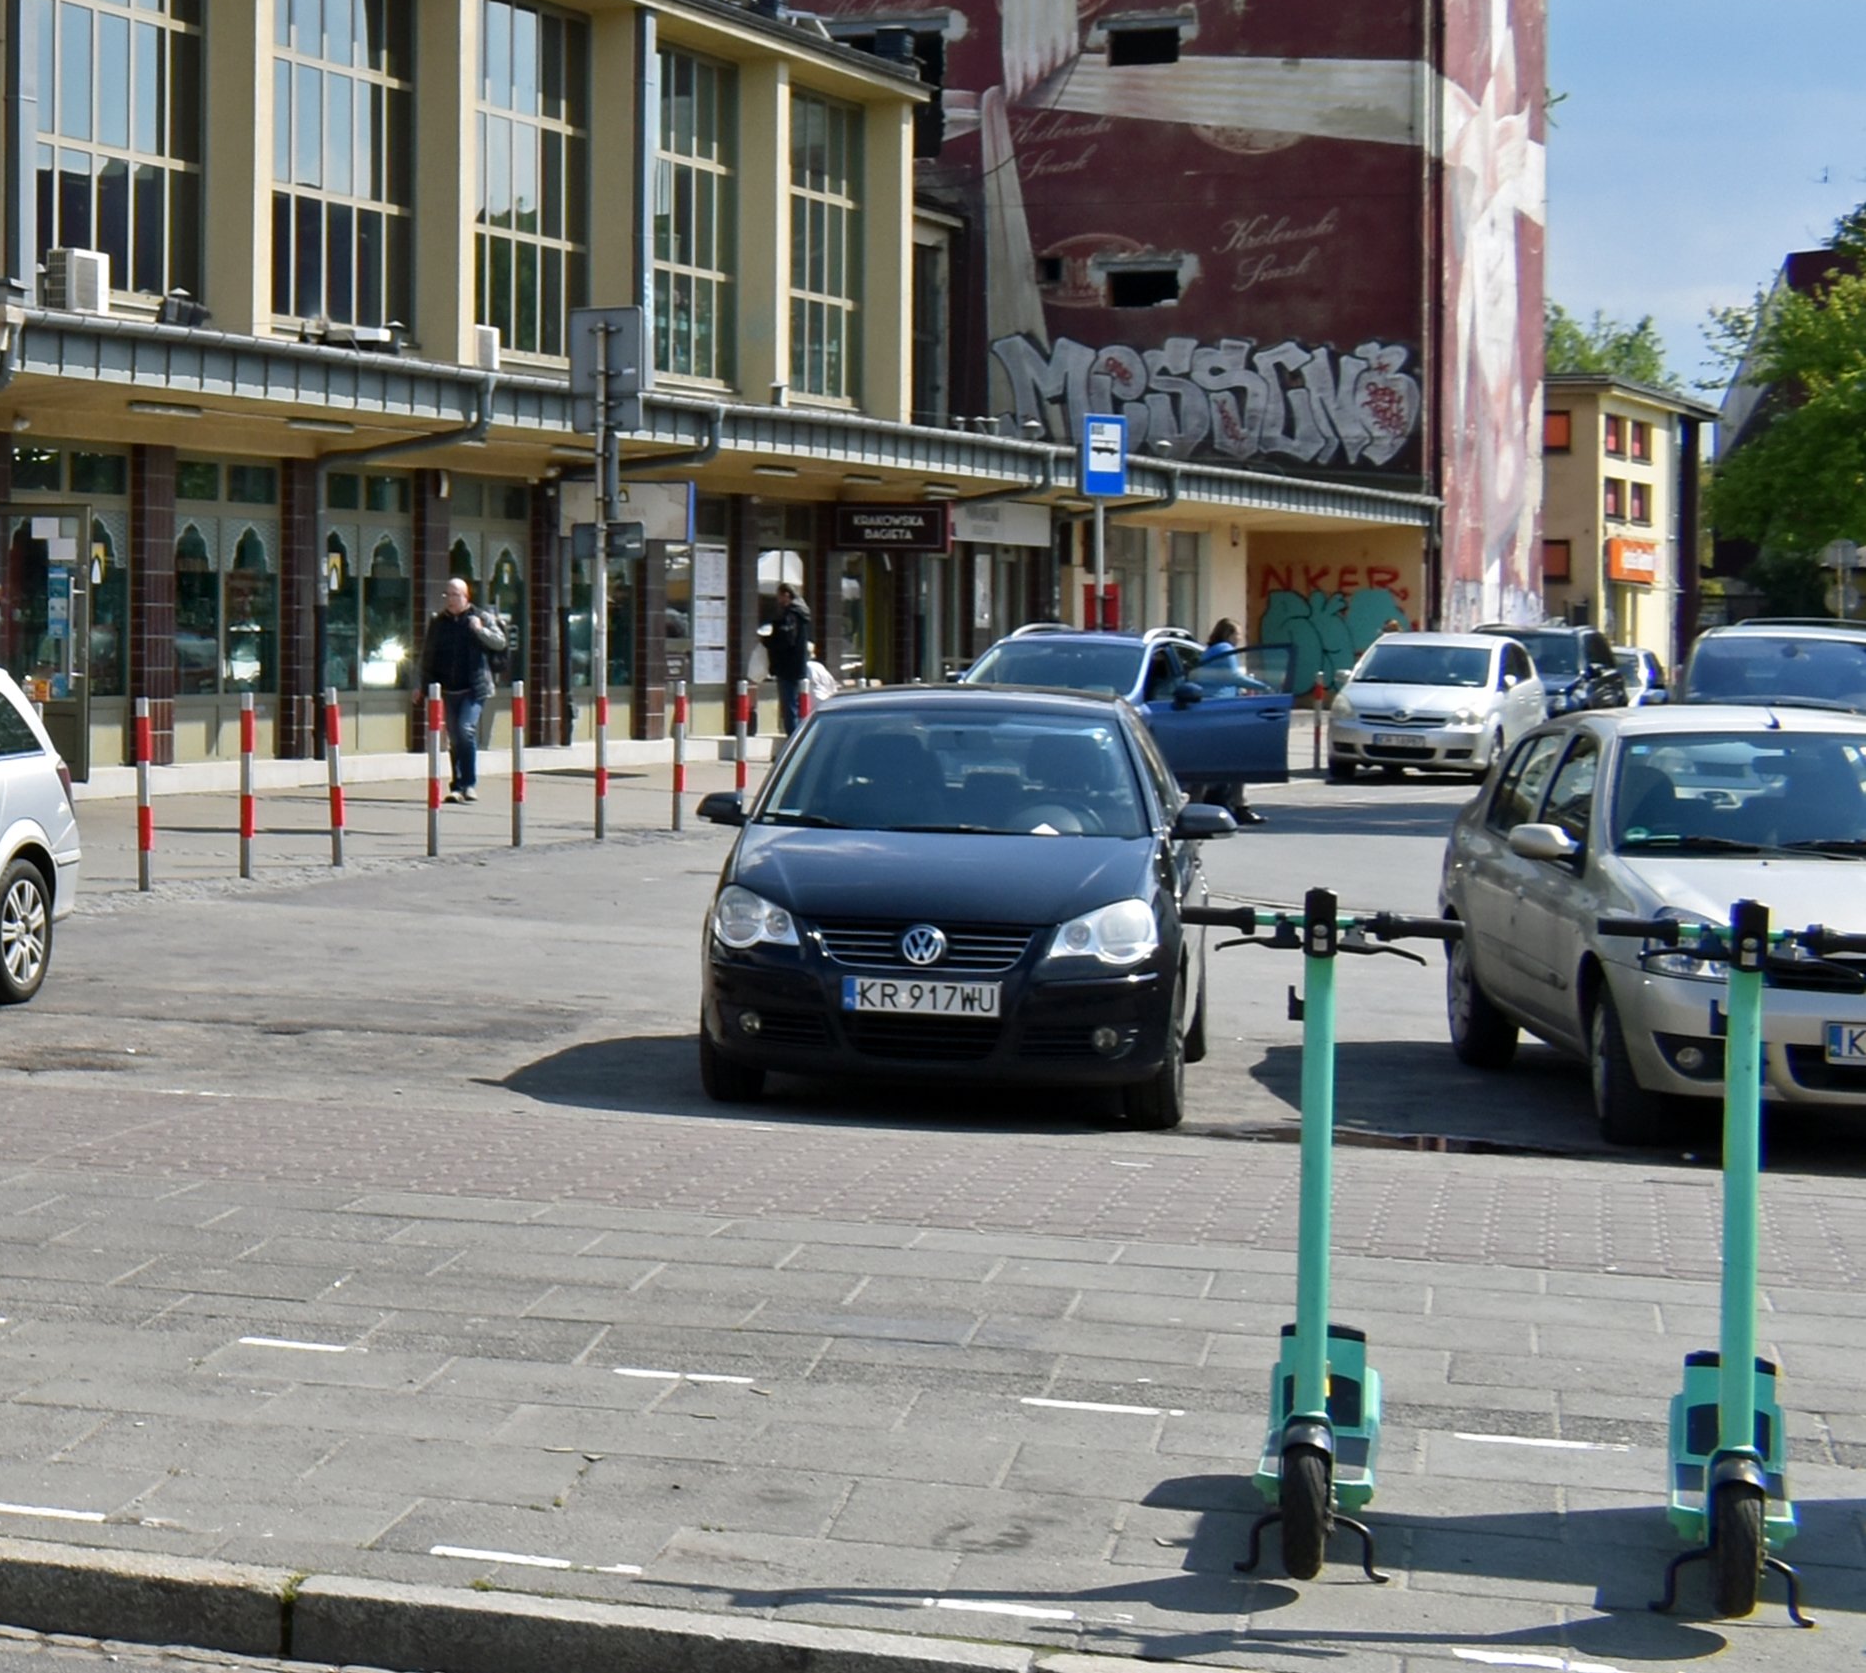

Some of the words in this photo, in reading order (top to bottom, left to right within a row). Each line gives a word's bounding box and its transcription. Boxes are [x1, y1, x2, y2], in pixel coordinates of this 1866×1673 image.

[852, 515, 925, 527] KRAKOWSKA
[859, 981, 898, 1008] KR
[909, 984, 995, 1013] 917WU
